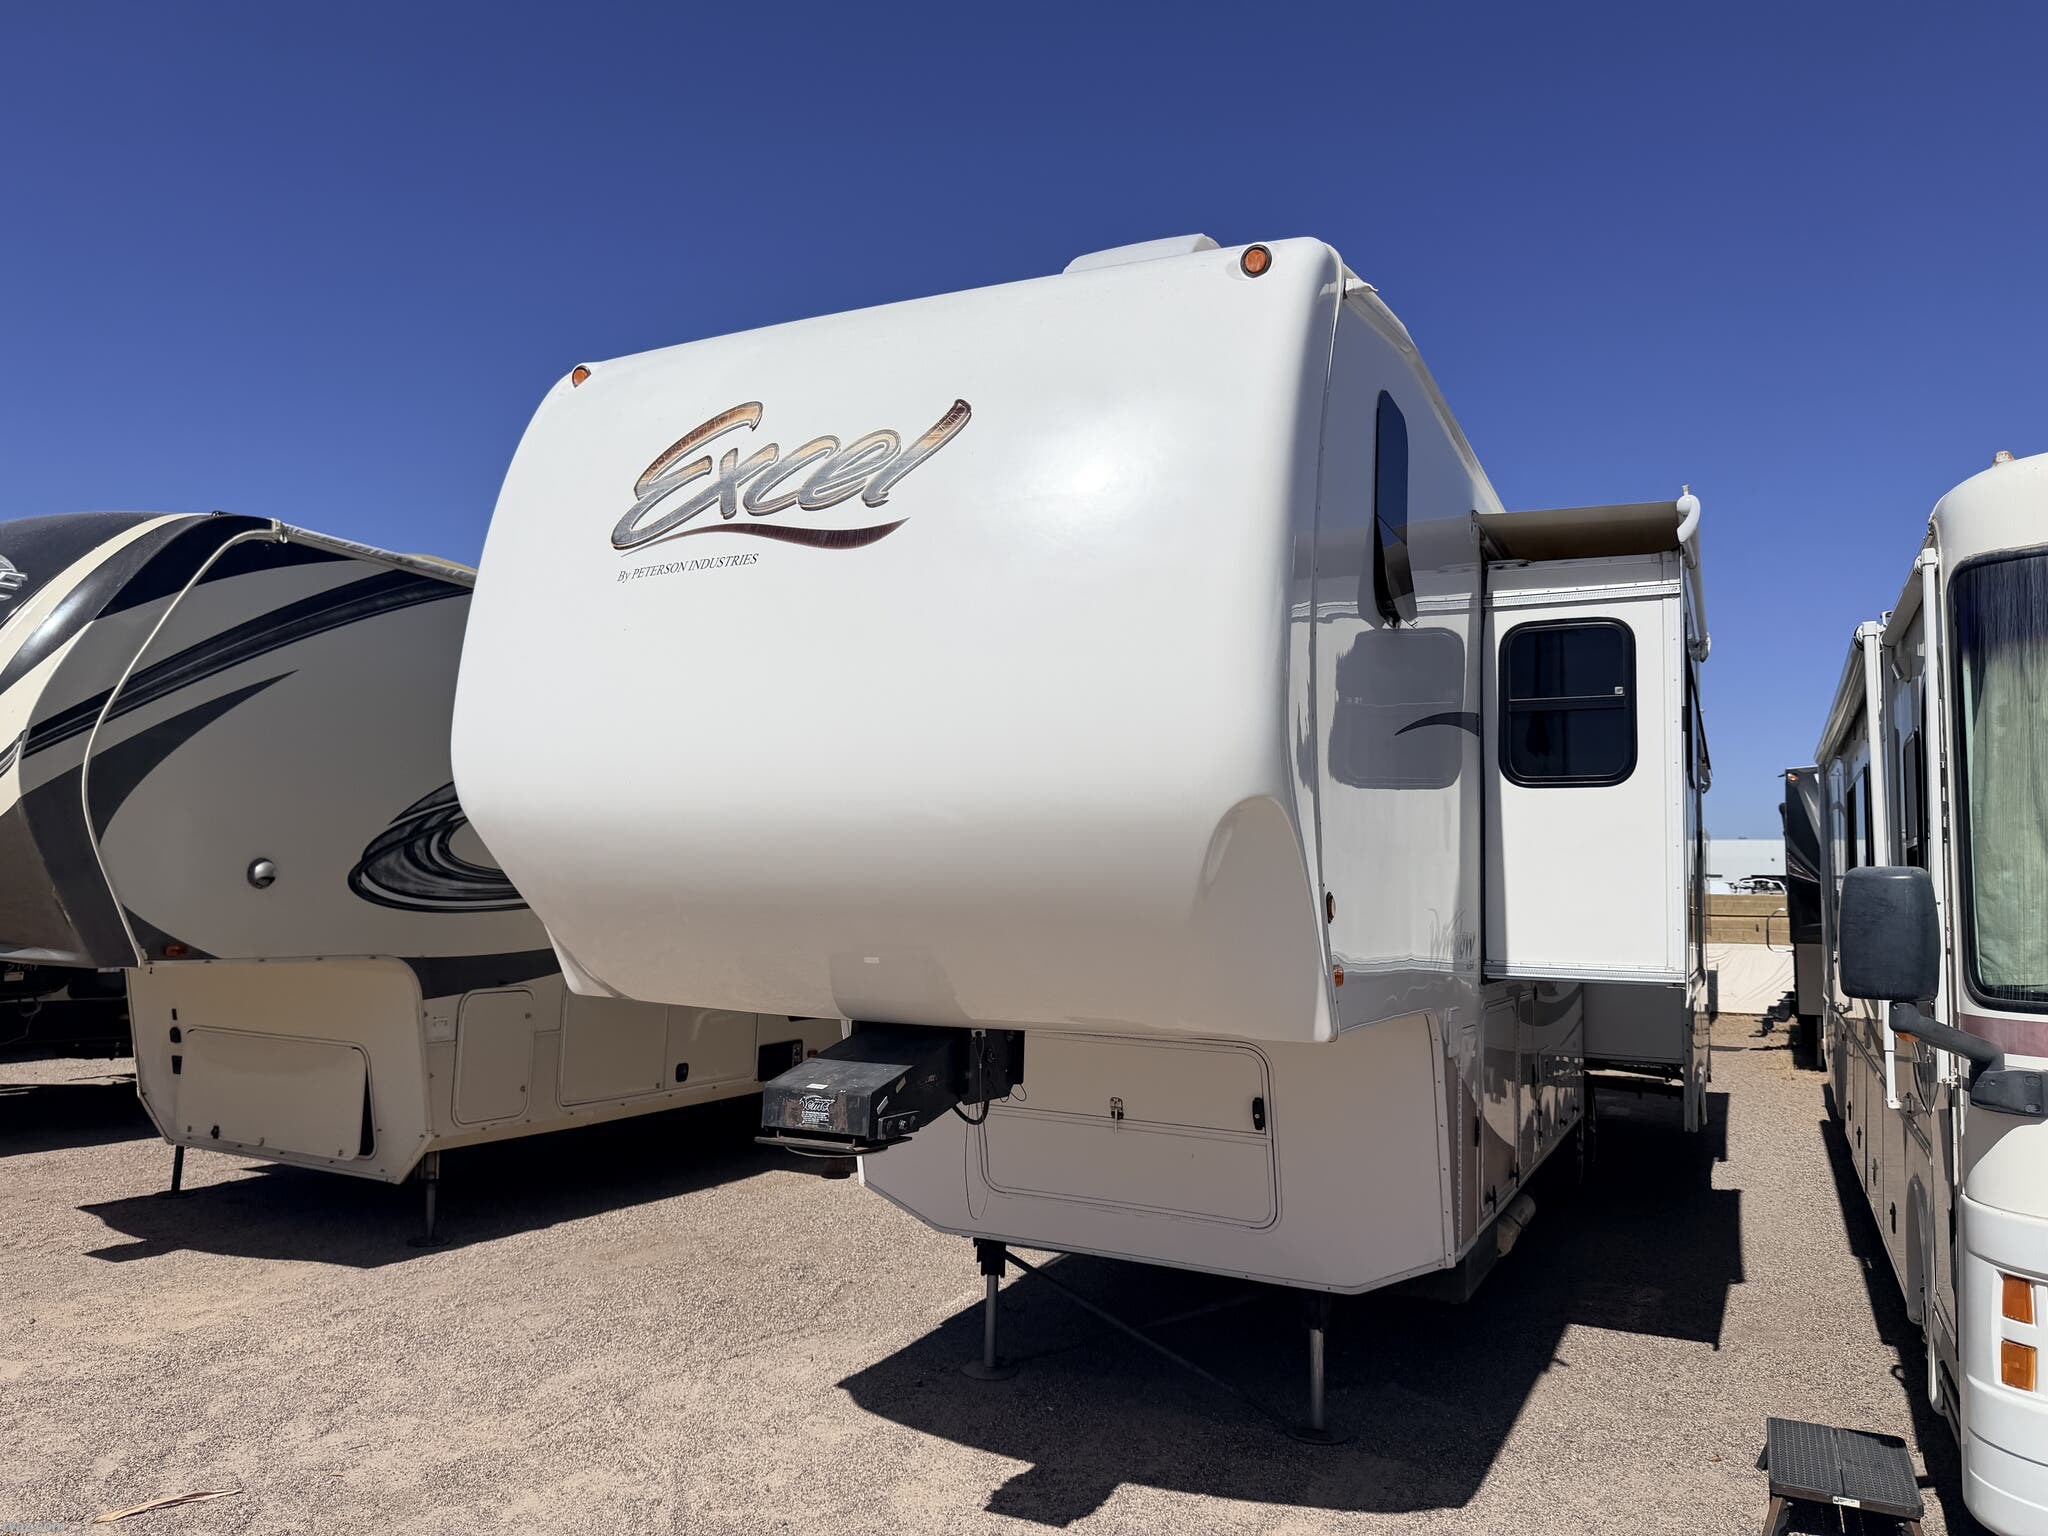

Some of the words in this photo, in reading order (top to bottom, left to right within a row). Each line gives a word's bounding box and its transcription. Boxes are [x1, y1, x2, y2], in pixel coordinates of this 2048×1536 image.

[611, 399, 972, 550] Excel
[617, 570, 631, 583] By
[631, 560, 687, 579] PETERSON
[688, 553, 759, 571] INDUSTRIES
